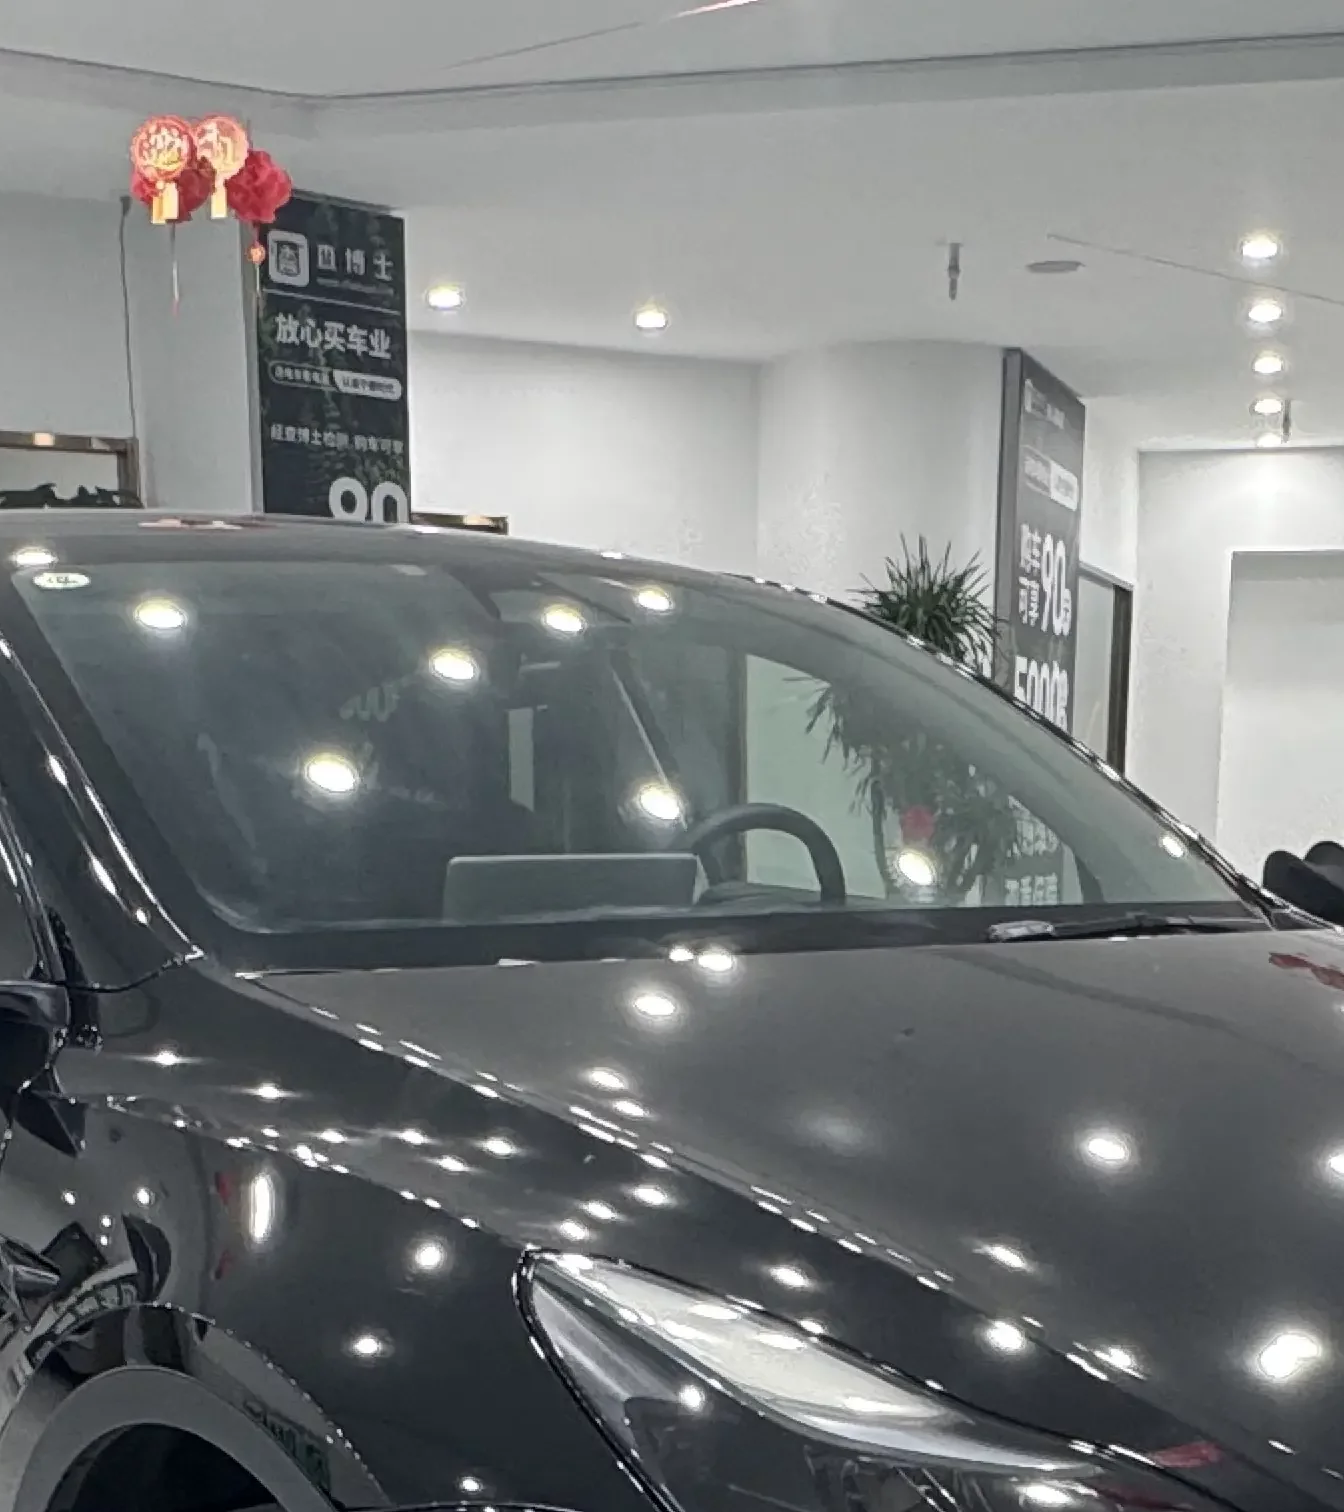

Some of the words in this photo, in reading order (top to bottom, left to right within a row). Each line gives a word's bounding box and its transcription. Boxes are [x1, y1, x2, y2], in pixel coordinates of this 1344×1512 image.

[274, 312, 393, 360] 放心买车业
